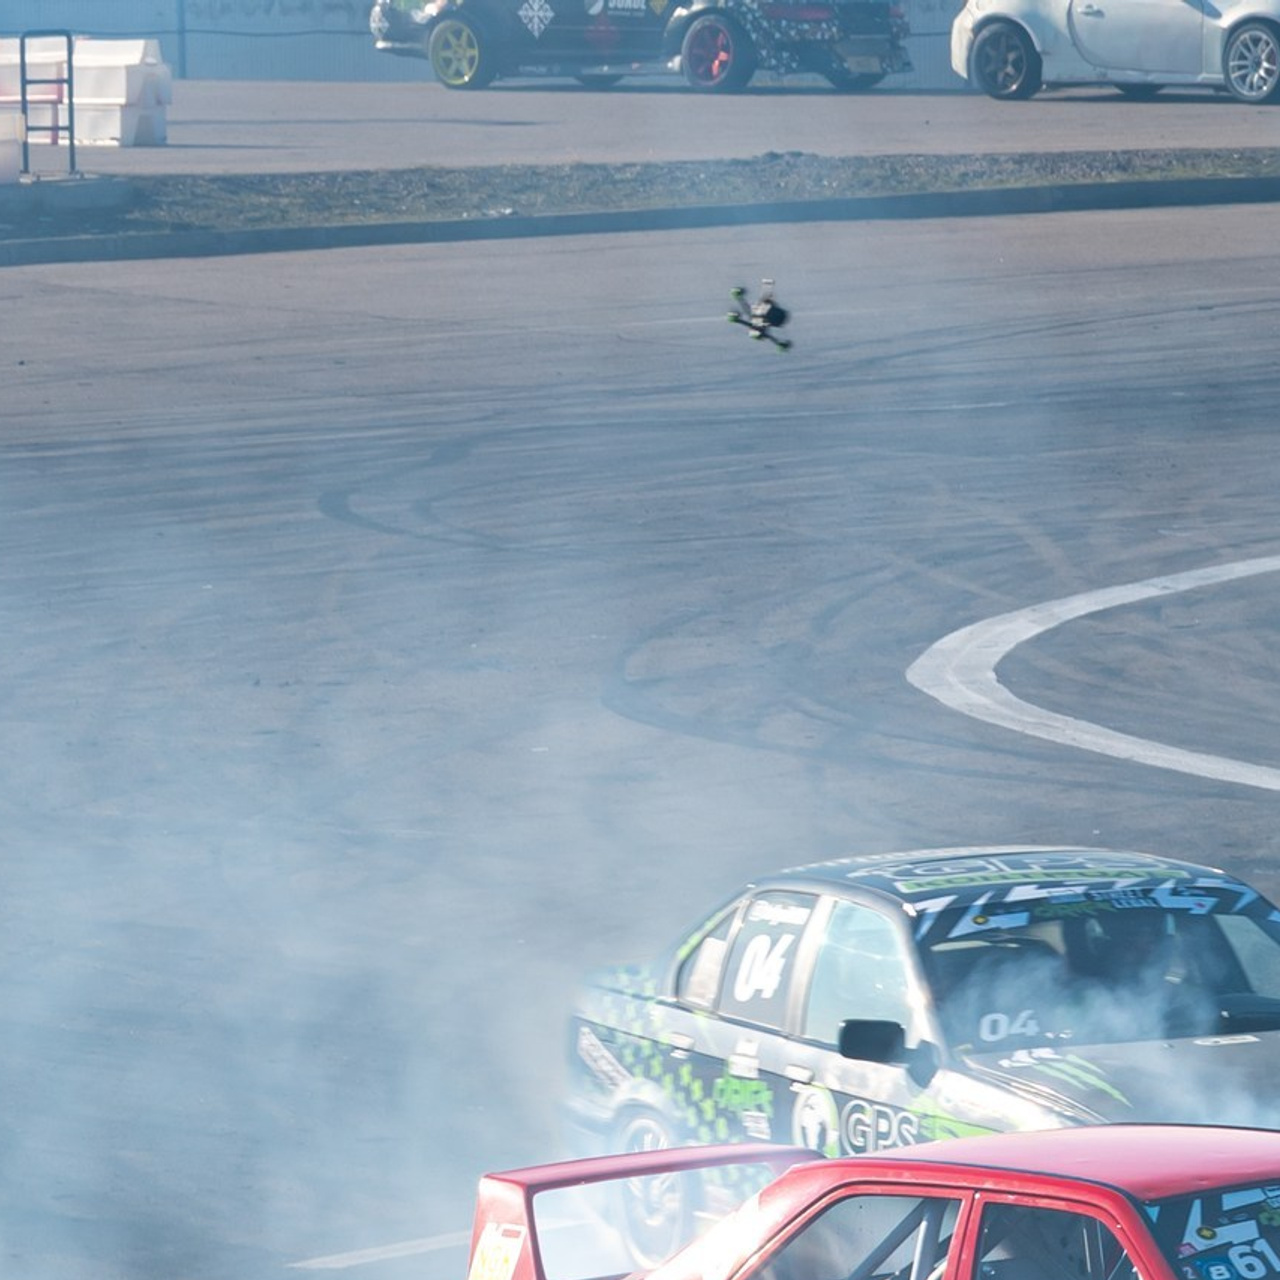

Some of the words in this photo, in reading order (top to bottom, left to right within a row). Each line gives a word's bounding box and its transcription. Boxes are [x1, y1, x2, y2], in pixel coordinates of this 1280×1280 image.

[734, 933, 795, 1002] 04
[980, 1010, 1040, 1041] 04
[841, 1100, 918, 1156] GPS
[1209, 1265, 1231, 1280] 8
